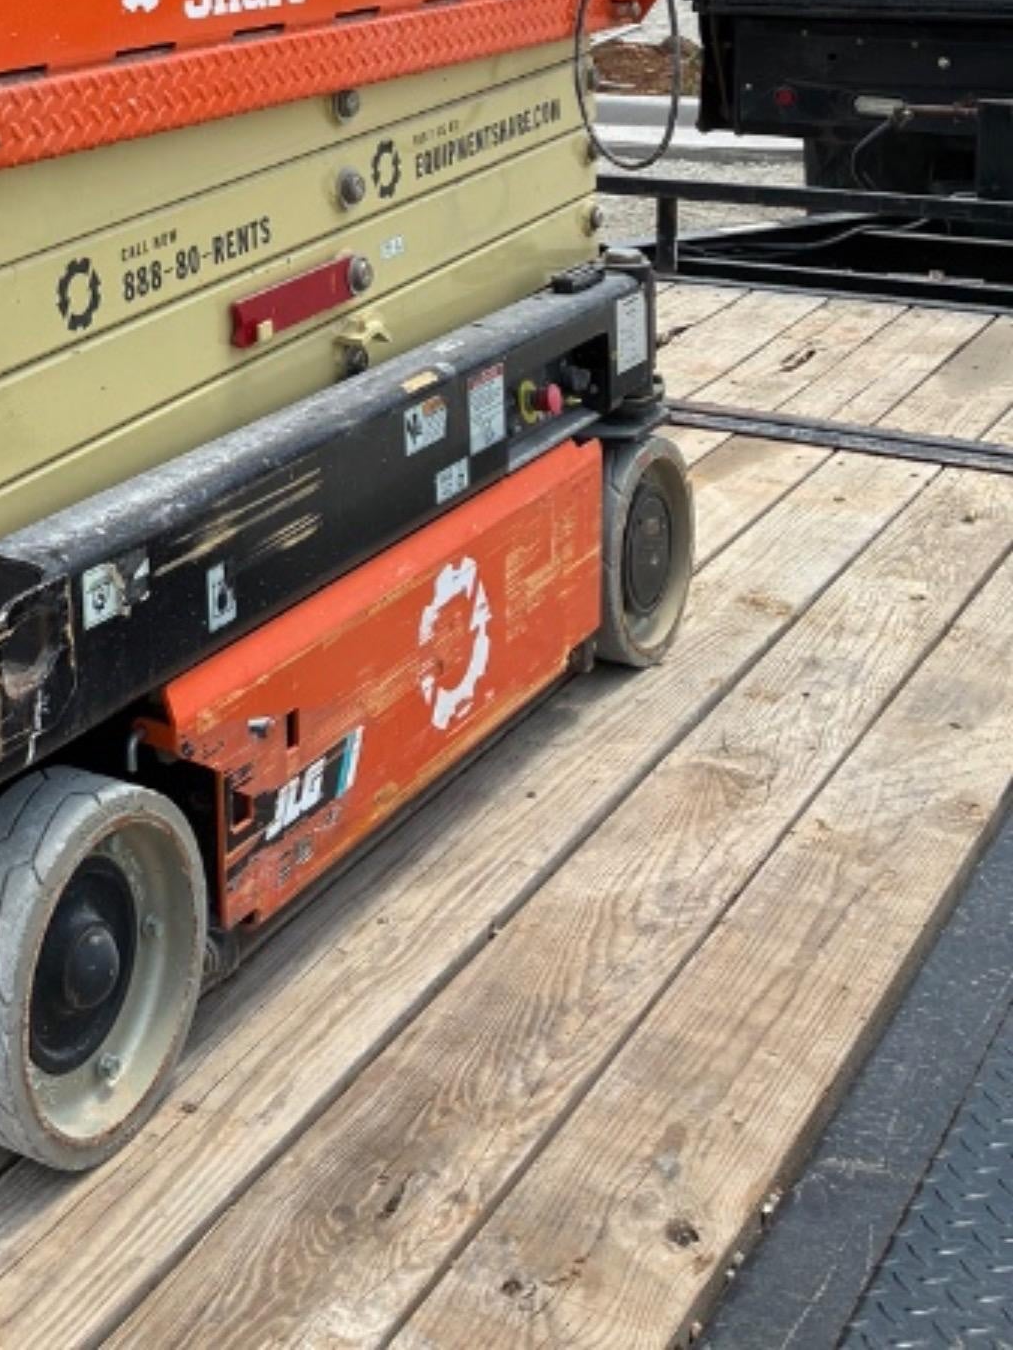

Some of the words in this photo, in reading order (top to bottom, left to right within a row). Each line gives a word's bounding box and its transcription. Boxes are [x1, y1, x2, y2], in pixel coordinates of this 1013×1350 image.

[414, 98, 562, 180] EQUIPMENTSHARE.COM
[123, 215, 271, 302] 888-80-RENTS
[264, 757, 327, 840] JLG
